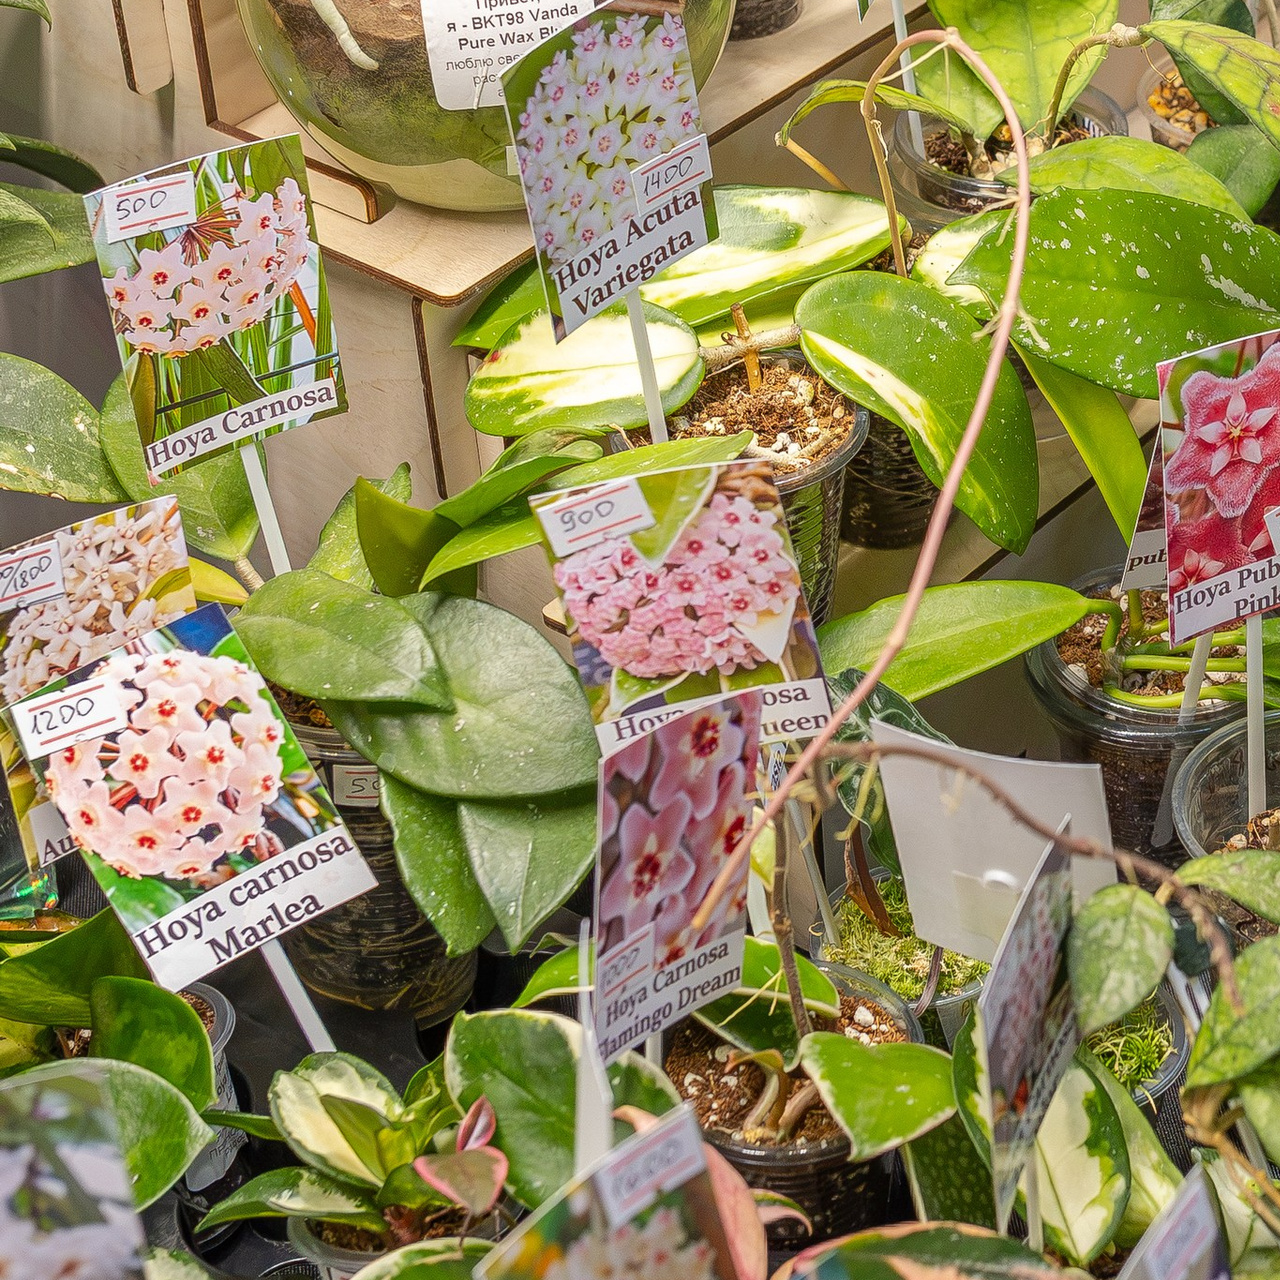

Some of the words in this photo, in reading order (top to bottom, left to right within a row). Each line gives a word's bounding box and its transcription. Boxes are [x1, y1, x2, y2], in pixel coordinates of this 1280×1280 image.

[530, 3, 578, 21] Vanda
[458, 36, 495, 51] Pure
[499, 31, 535, 46] Wax
[446, 56, 494, 72] люблю
[643, 156, 694, 195] 1400
[116, 189, 167, 223] 500
[555, 237, 620, 294] Hoya
[625, 190, 700, 248] Acuta
[572, 230, 695, 319] Variegata
[149, 423, 217, 469] Hoya
[222, 382, 335, 443] Carnosa
[560, 498, 615, 533] 900
[1176, 580, 1230, 615] Hoya
[31, 697, 95, 735] 1200
[763, 714, 829, 737] ueen
[134, 909, 222, 960] Hoya
[226, 831, 353, 908] carnosa
[206, 891, 324, 968] Marlea
[605, 992, 648, 1029] Hoya
[653, 941, 729, 994] Carnosa
[677, 964, 742, 1011] Dream
